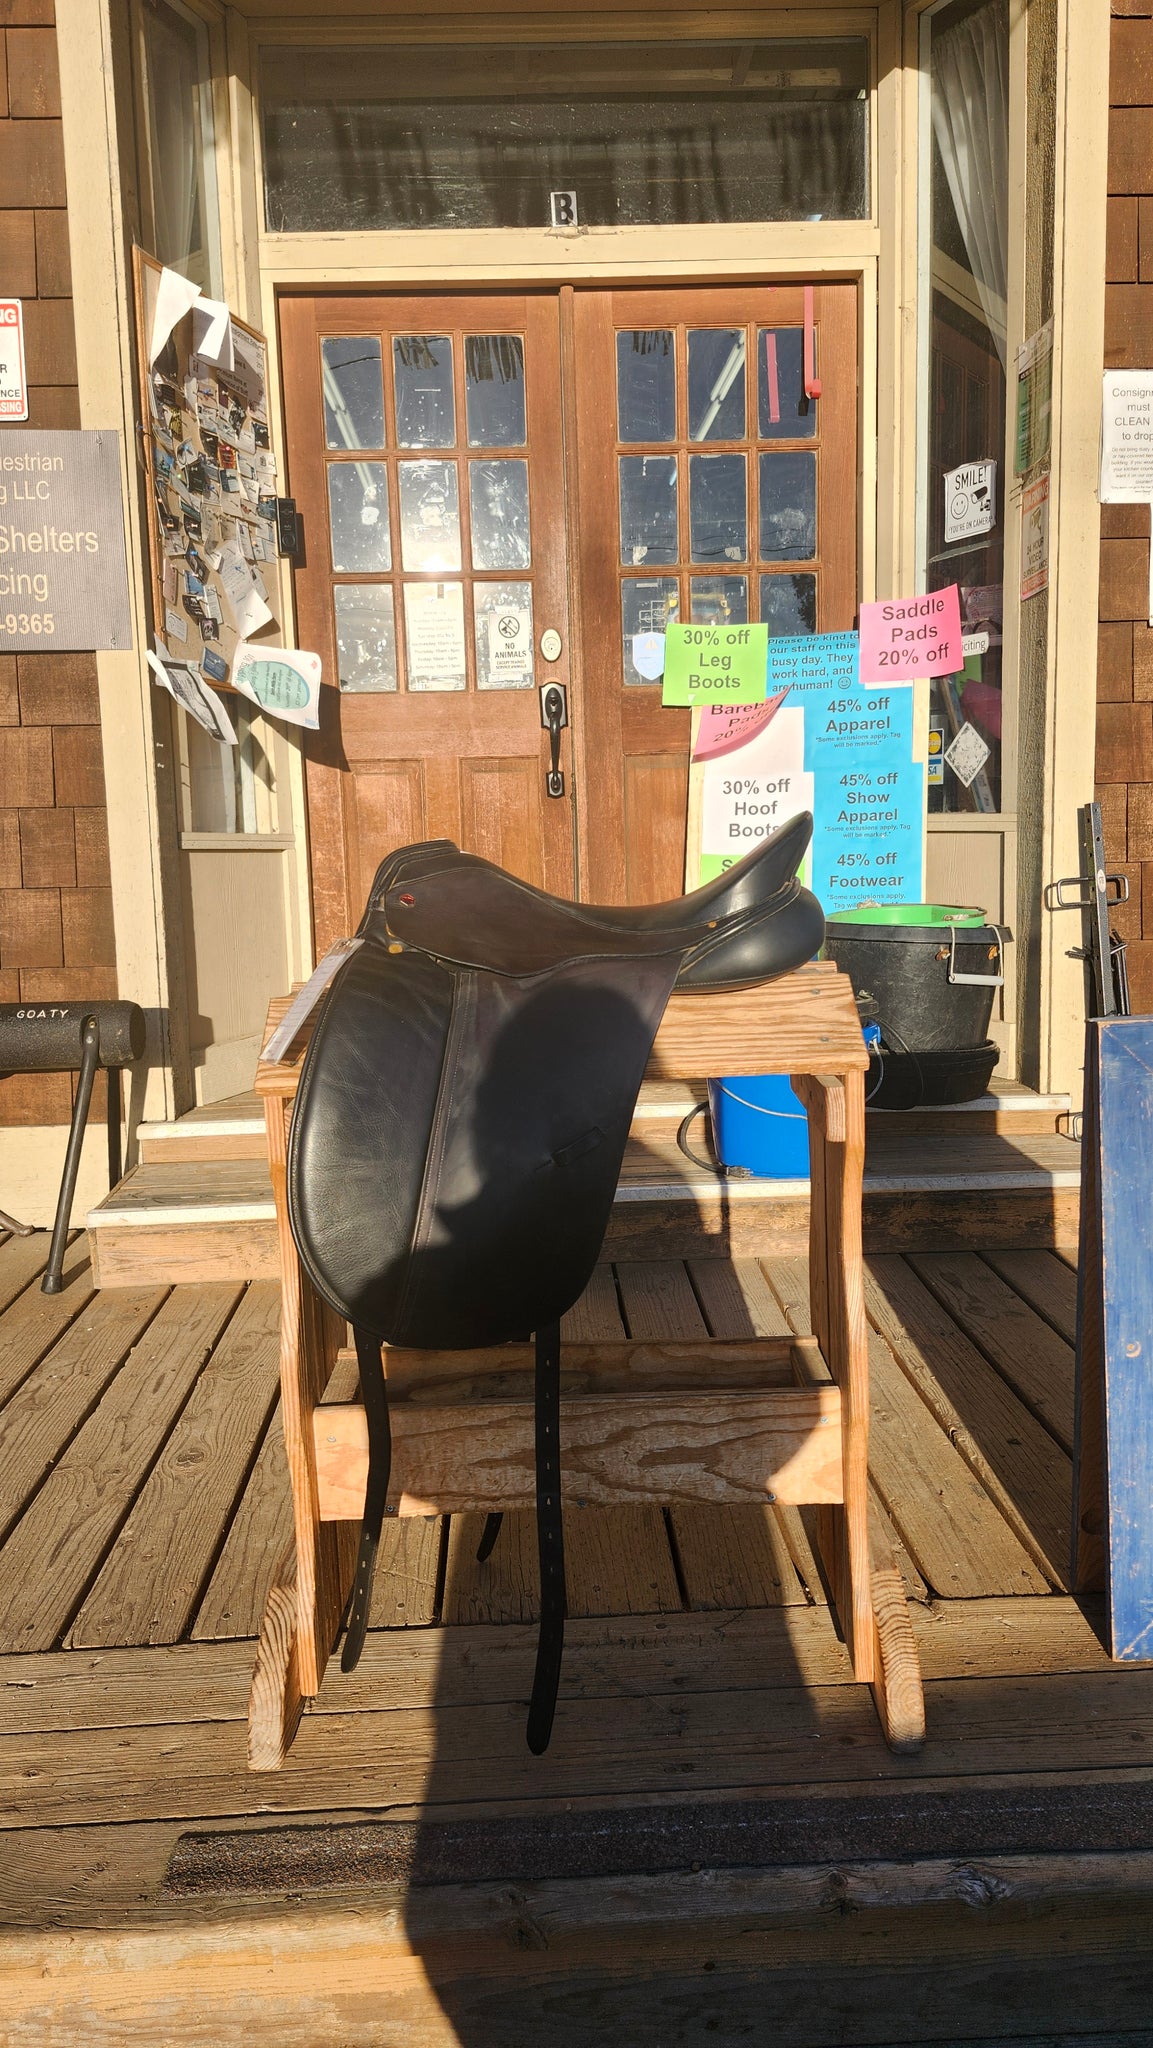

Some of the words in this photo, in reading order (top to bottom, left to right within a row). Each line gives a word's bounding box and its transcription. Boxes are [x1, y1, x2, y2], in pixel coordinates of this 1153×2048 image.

[554, 193, 574, 225] B
[1112, 388, 1153, 399] Consign
[1127, 402, 1150, 411] must
[1114, 416, 1150, 426] CLEAN
[1122, 431, 1131, 440] to
[0, 452, 64, 471] estrian
[955, 465, 987, 491] SMILE!
[13, 480, 50, 500] LLC
[882, 599, 945, 621] Saddle
[683, 629, 720, 646] 30%
[726, 629, 751, 645] off
[823, 633, 846, 641] kind
[891, 624, 938, 643] Pads
[495, 650, 527, 658] ANIMALS
[791, 644, 815, 653] staff
[836, 641, 856, 649] this
[878, 649, 919, 666] 20%
[926, 642, 949, 662] off
[699, 652, 732, 671] Leg
[772, 657, 798, 667] busy
[801, 655, 823, 665] day.
[827, 653, 853, 663] They
[772, 669, 798, 679] work
[801, 667, 829, 677] hard,
[832, 665, 853, 675] and
[689, 674, 741, 689] Boots
[792, 680, 833, 691] human!
[827, 698, 862, 713] 45%
[867, 697, 890, 711] off
[825, 716, 890, 734] Apparel
[928, 765, 937, 775] SA
[839, 773, 872, 786] 45%
[877, 772, 898, 785] off
[722, 779, 760, 795] 30%
[766, 778, 791, 793] off
[846, 791, 890, 804] Show
[734, 800, 778, 816] Hoof
[837, 808, 898, 825] Apparel
[880, 823, 898, 831] apply.
[837, 853, 870, 866] 45%
[875, 852, 898, 865] off
[829, 875, 904, 888] Footwear
[886, 892, 906, 900] apply.
[16, 1009, 69, 1019] GOATY
